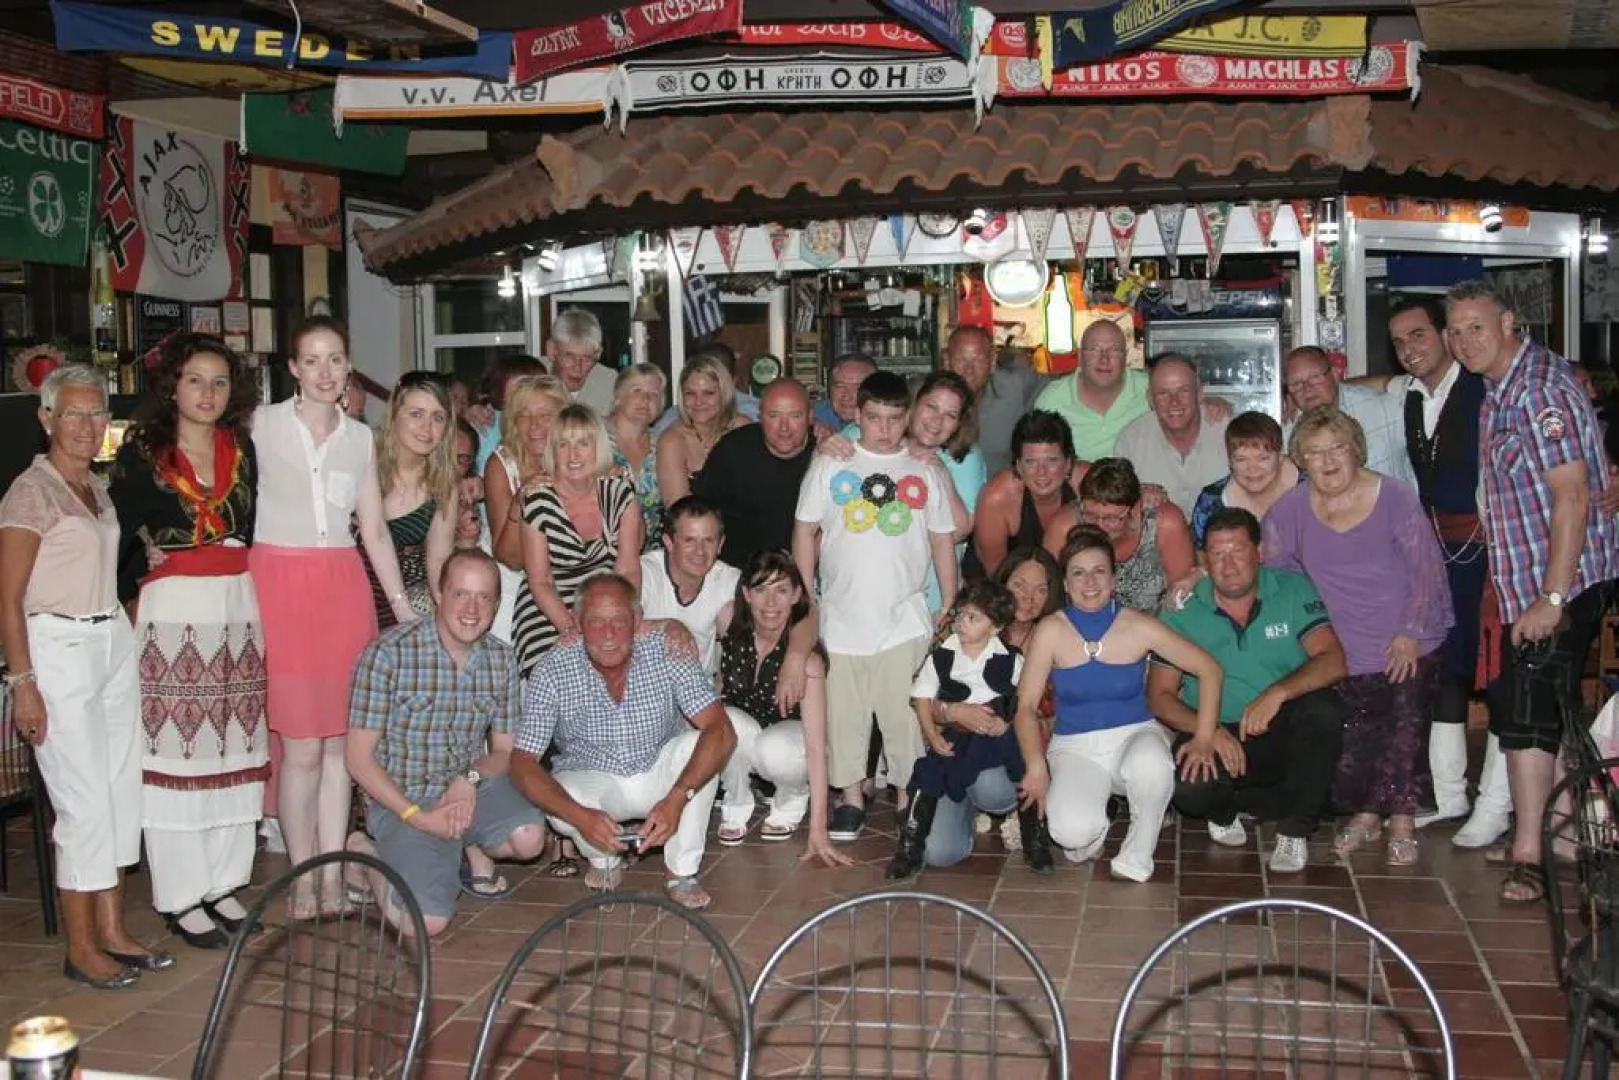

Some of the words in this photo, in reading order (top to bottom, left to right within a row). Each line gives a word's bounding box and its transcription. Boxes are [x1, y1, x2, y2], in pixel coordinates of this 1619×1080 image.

[690, 68, 765, 93] ΟΦΗ
[831, 66, 907, 89] ΟΦΗ
[1068, 61, 1161, 82] NIKOS
[1225, 59, 1339, 80] MACHLAS
[402, 87, 457, 105] v.v.
[473, 76, 549, 102] Axel
[143, 302, 180, 317] GUINNESS
